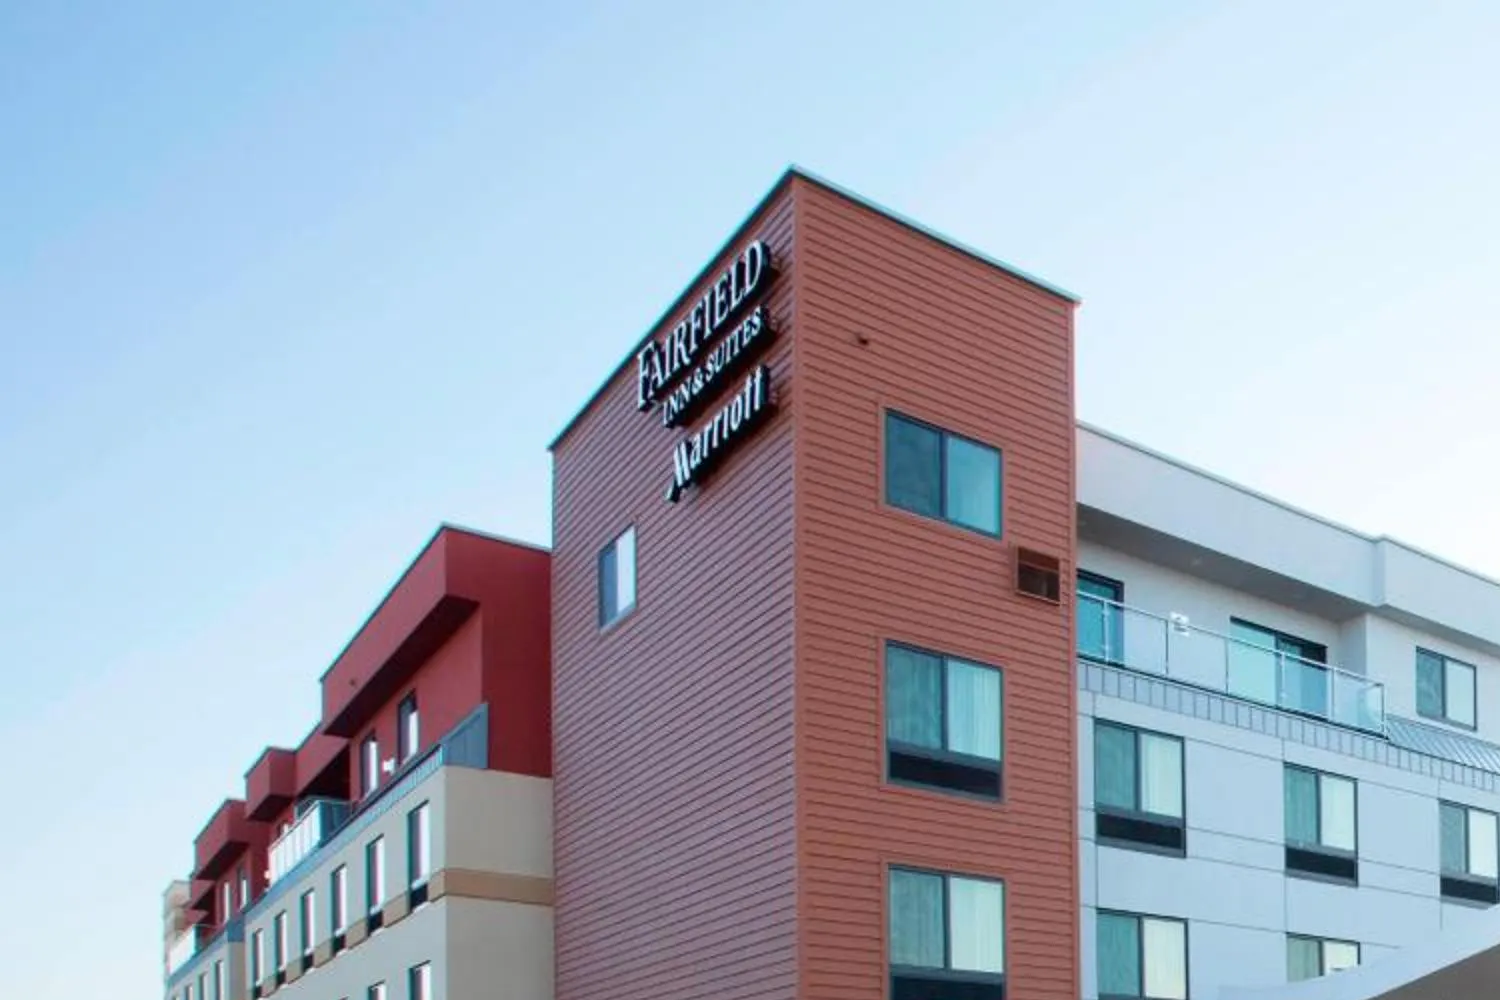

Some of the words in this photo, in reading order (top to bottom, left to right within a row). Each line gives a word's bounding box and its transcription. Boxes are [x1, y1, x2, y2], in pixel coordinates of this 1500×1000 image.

[637, 240, 767, 409] FAIRFIELD
[663, 376, 691, 425] INN
[705, 306, 763, 382] SUITES
[665, 365, 766, 500] Marriott
